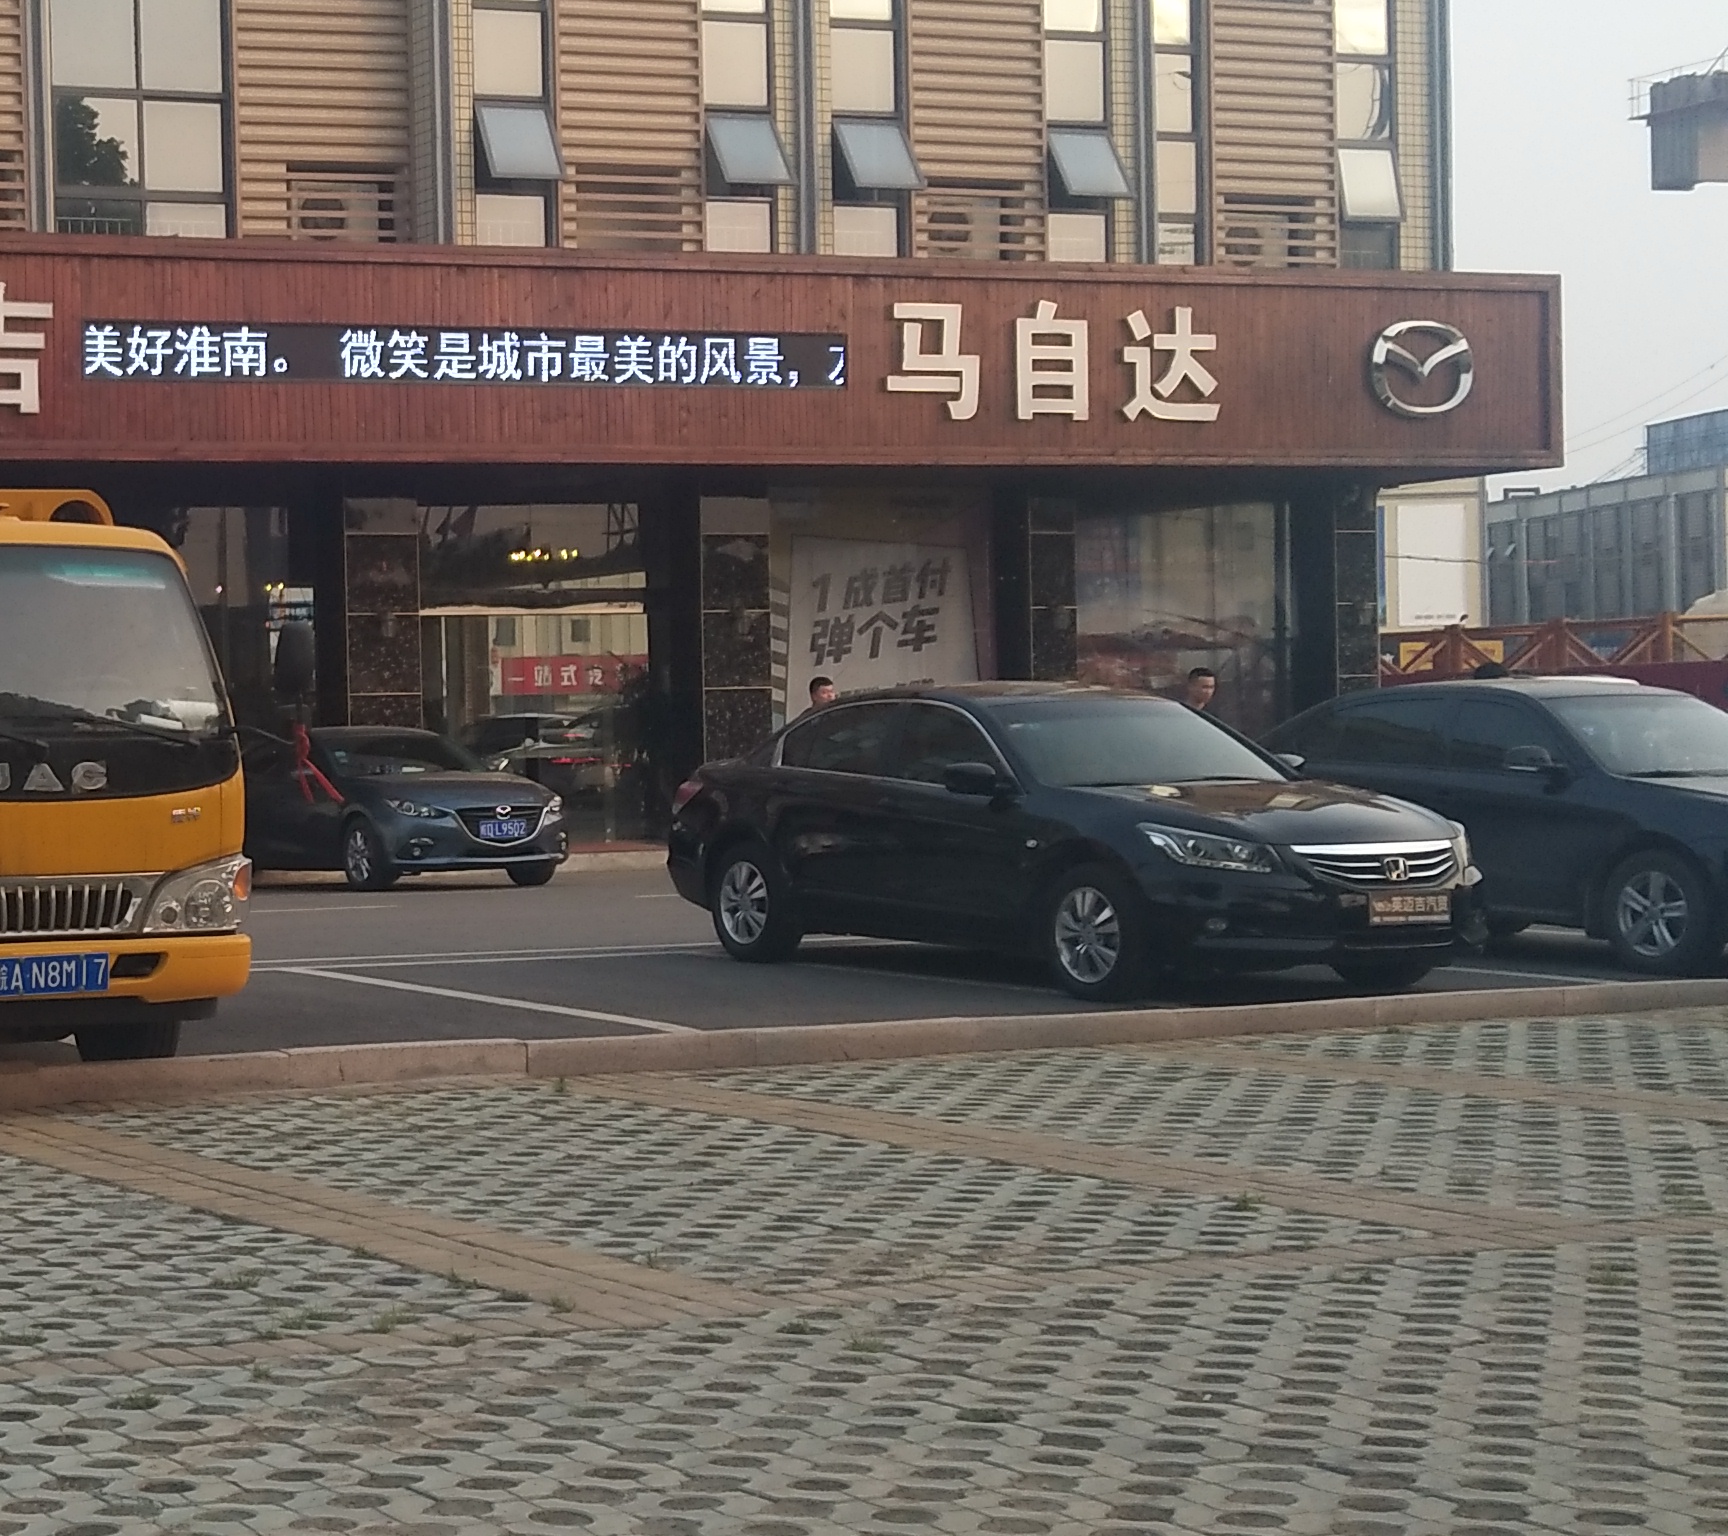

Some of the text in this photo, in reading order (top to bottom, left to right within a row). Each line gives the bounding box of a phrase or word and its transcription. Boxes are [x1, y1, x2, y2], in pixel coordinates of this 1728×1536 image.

[886, 300, 1222, 422] 马自达
[812, 558, 953, 612] 1成首付
[809, 604, 940, 666] 弹个车
